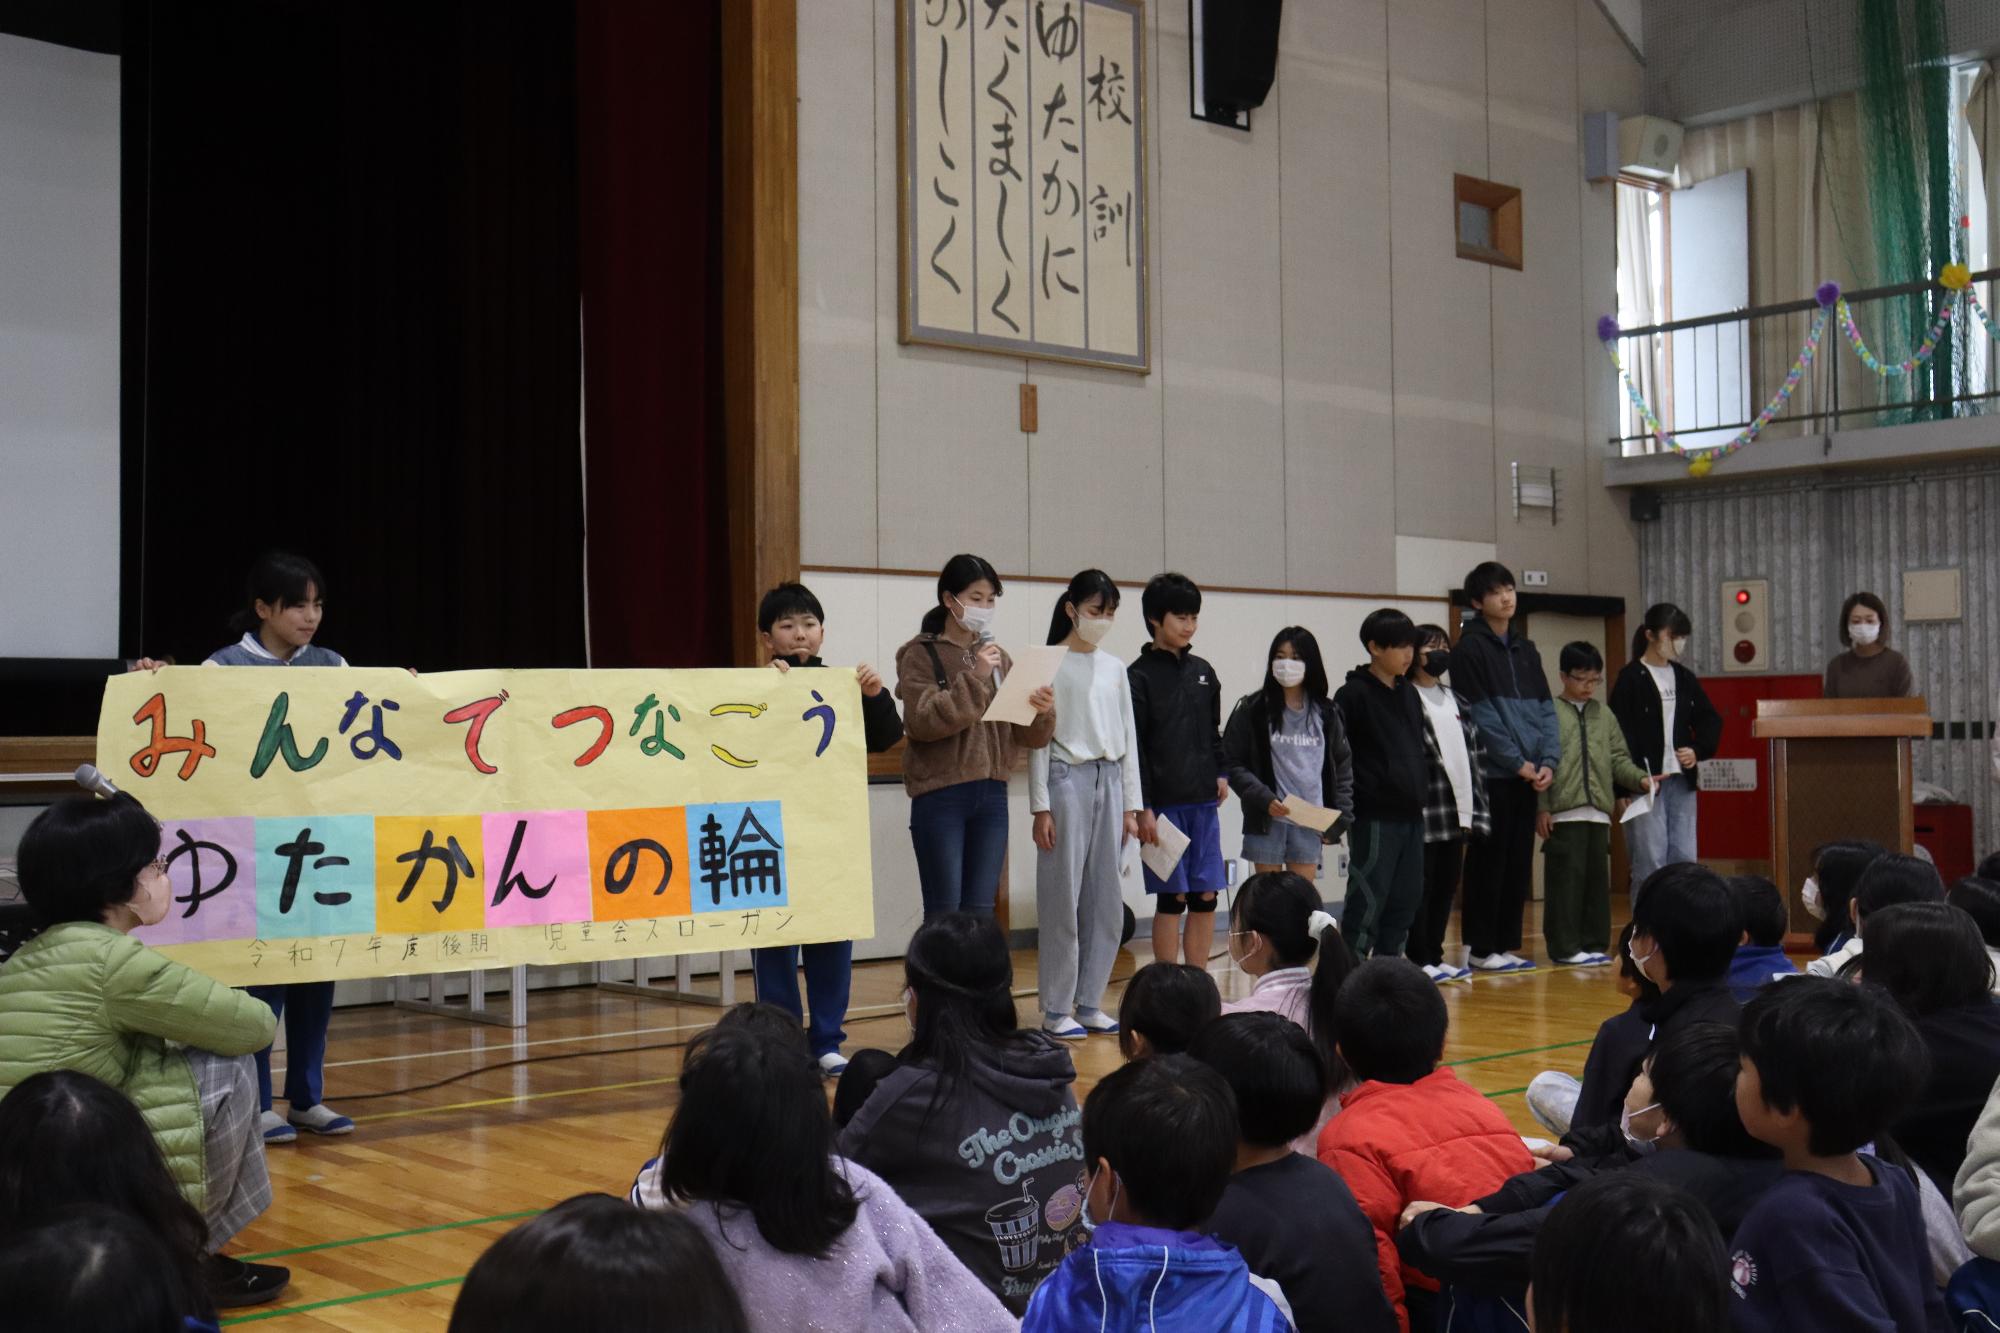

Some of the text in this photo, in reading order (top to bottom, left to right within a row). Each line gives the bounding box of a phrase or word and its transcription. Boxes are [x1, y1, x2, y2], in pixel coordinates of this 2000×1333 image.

[1035, 1, 1081, 300] ゆたかに
[1087, 55, 1132, 267] 校訓
[129, 688, 836, 781] みんなでつなごう
[163, 806, 783, 918] ゆたかんの輪
[544, 909, 793, 950] 児童会スローガン
[958, 1105, 1082, 1169] The Origin
